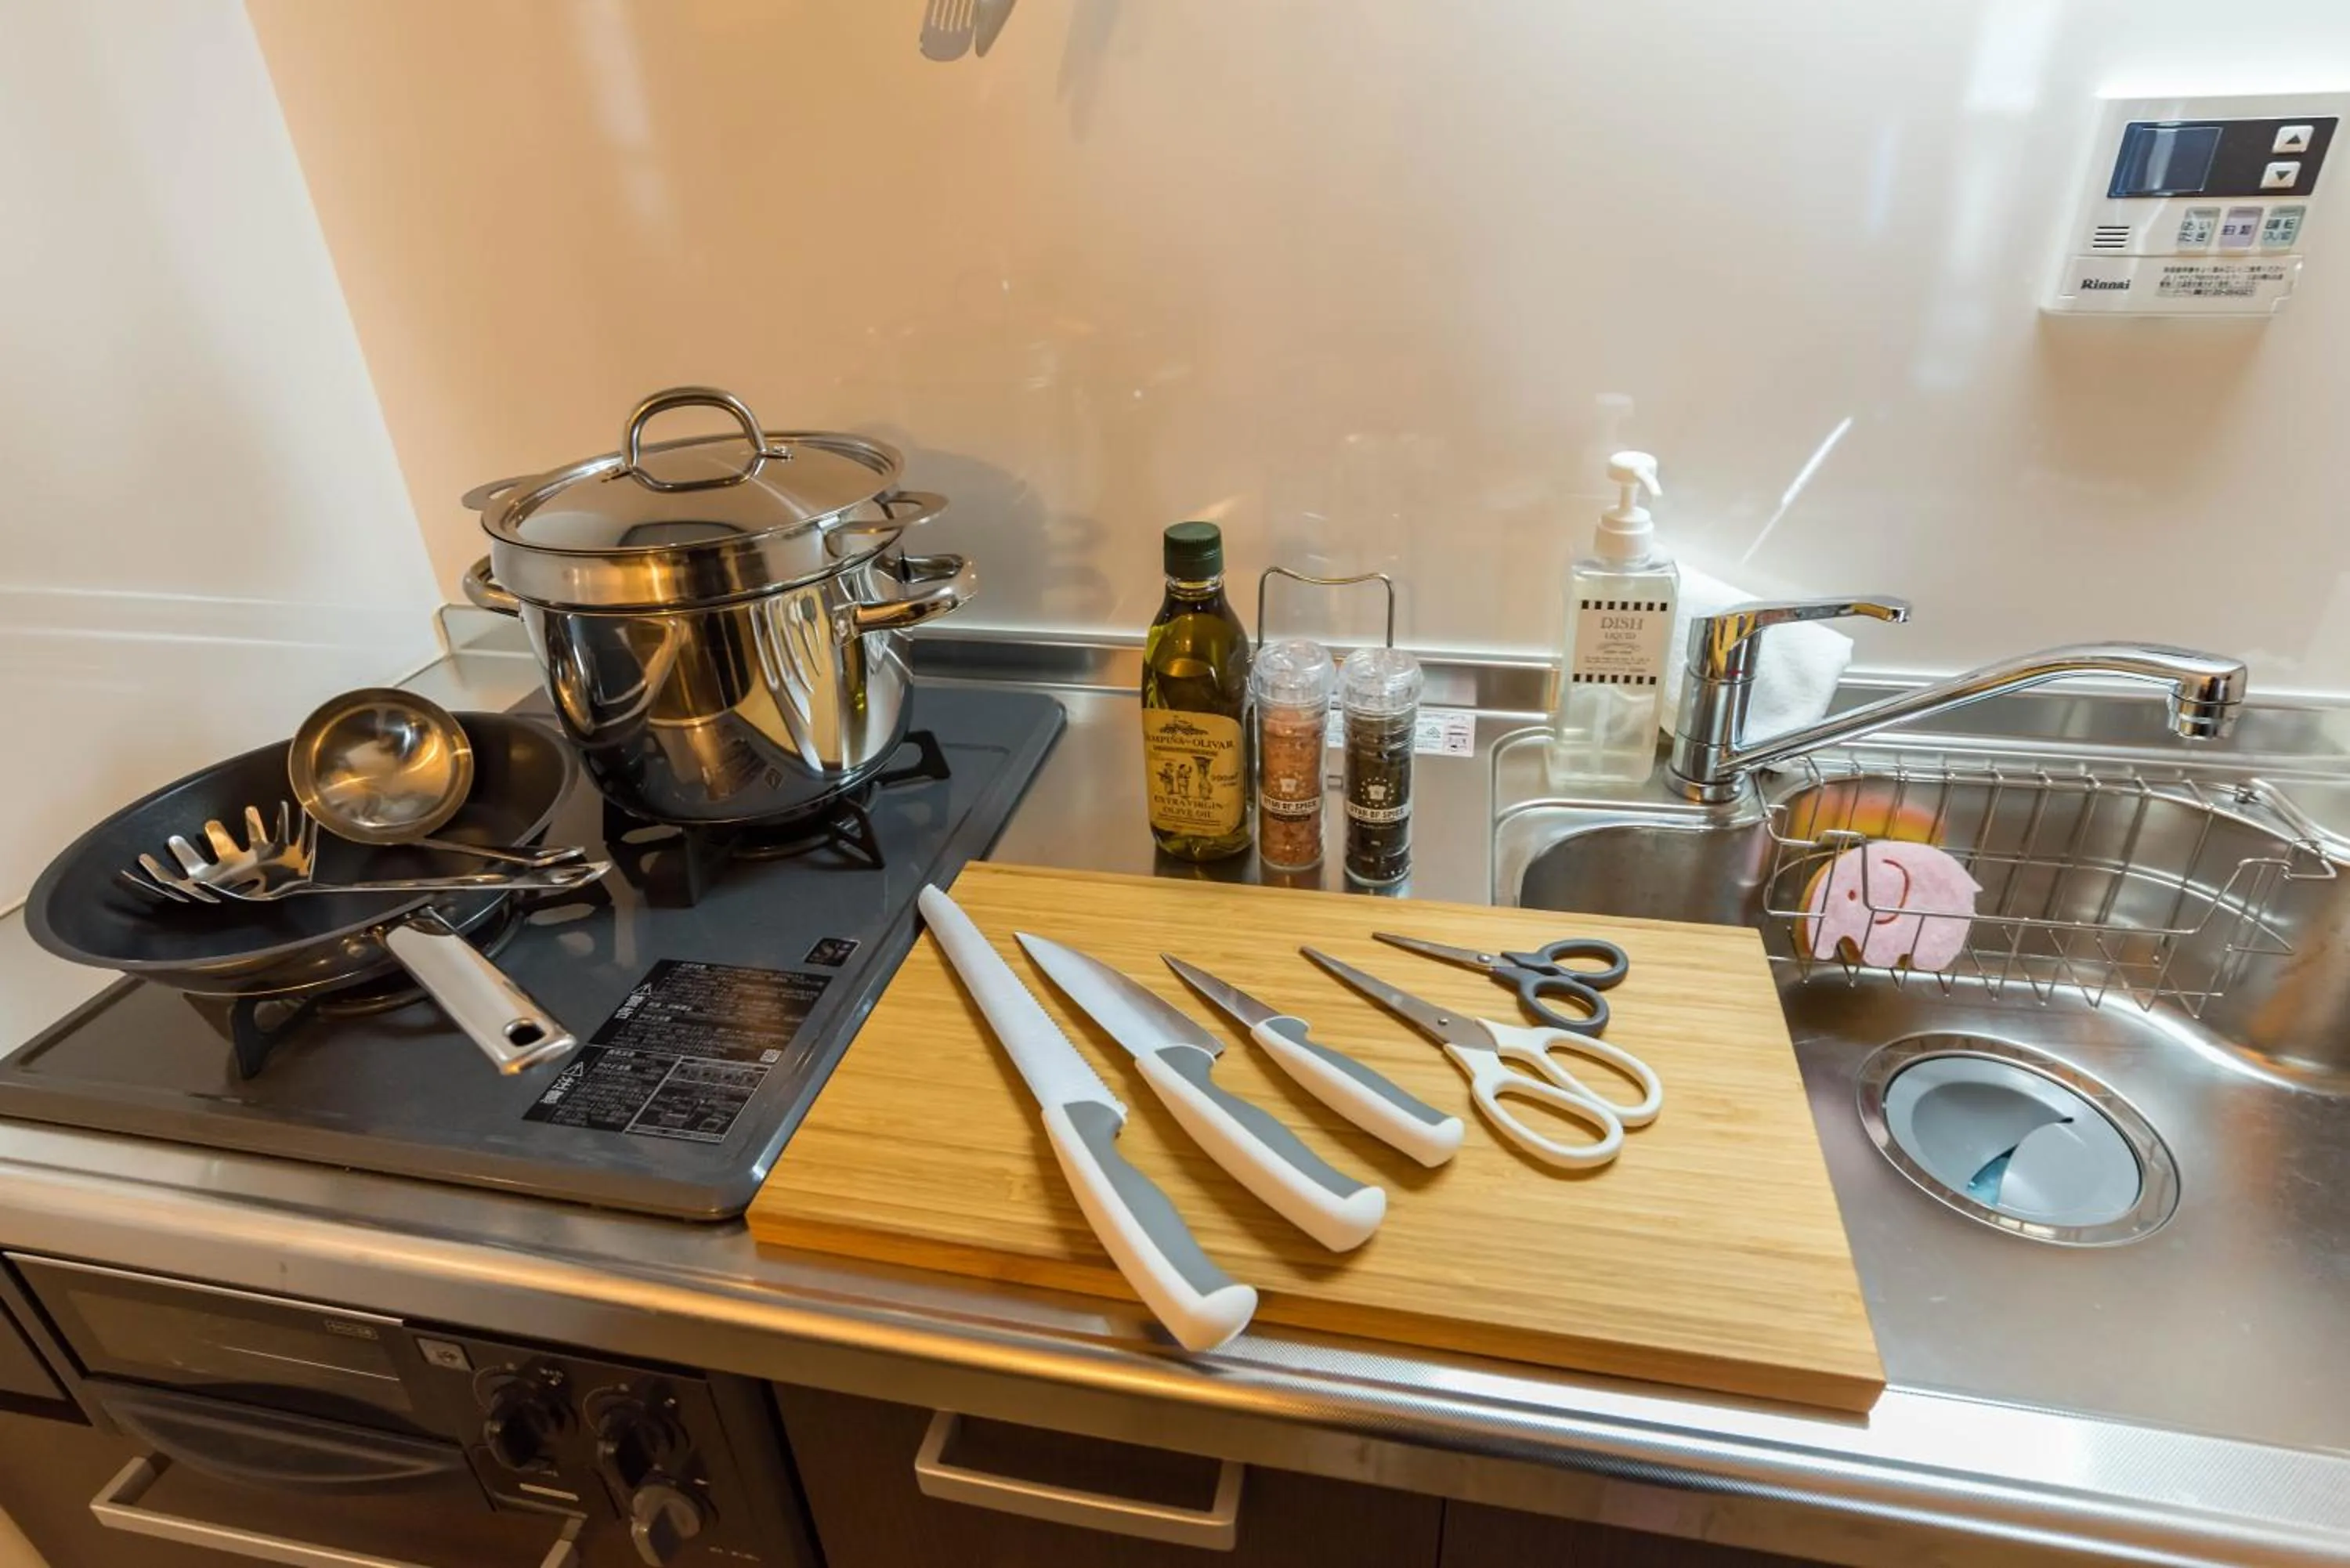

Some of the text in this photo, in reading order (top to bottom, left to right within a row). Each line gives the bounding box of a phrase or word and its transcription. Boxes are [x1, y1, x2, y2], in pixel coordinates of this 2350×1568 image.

[2081, 278, 2131, 290] Rinnai
[1600, 616, 1643, 630] DISH
[1604, 631, 1637, 640] LIQUID
[1154, 793, 1224, 811] EXTRA VIRGIN
[1162, 805, 1211, 818] OLIVE OIL
